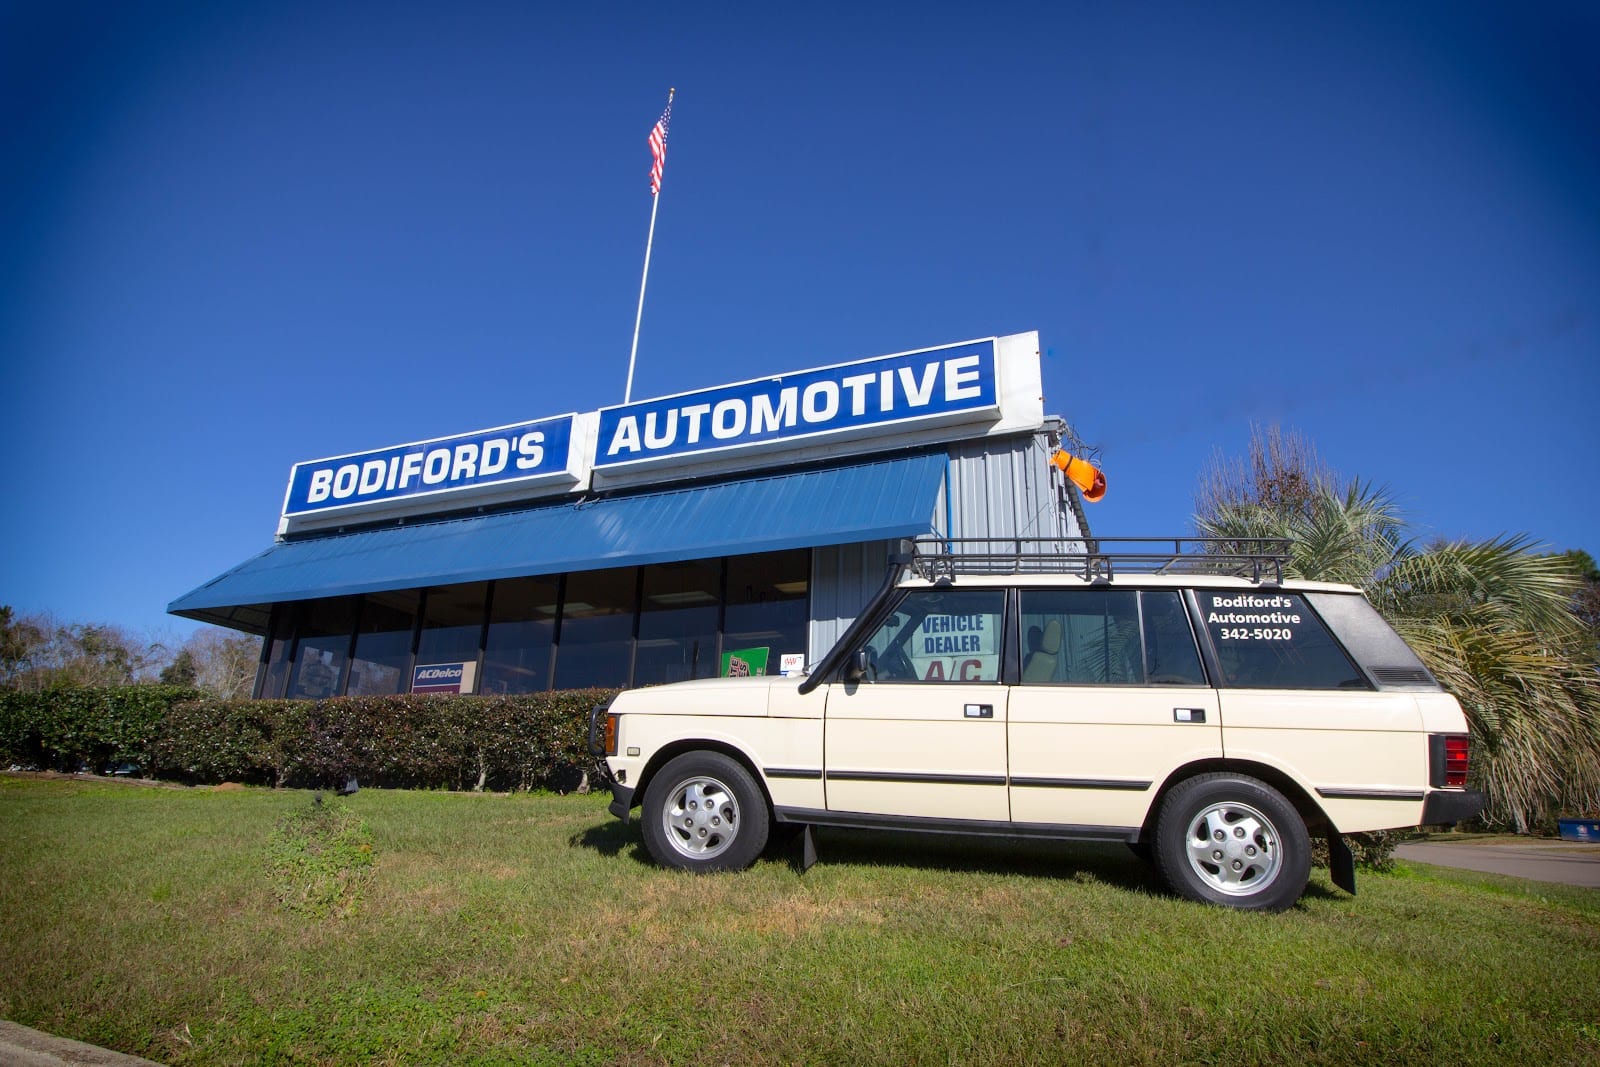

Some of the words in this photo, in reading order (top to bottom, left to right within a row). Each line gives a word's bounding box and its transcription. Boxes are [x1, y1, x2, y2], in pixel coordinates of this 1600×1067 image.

[307, 431, 545, 503] BODIFORD'S
[607, 355, 982, 456] AUTOMOTIVE
[1212, 596, 1292, 608] Bodiford's
[922, 614, 984, 634] VEHICLE
[1208, 612, 1300, 624] Automotive
[1220, 628, 1292, 640] 342-5020
[924, 635, 981, 654] DEALER
[417, 668, 462, 679] ACDelco
[924, 659, 982, 680] A/C
